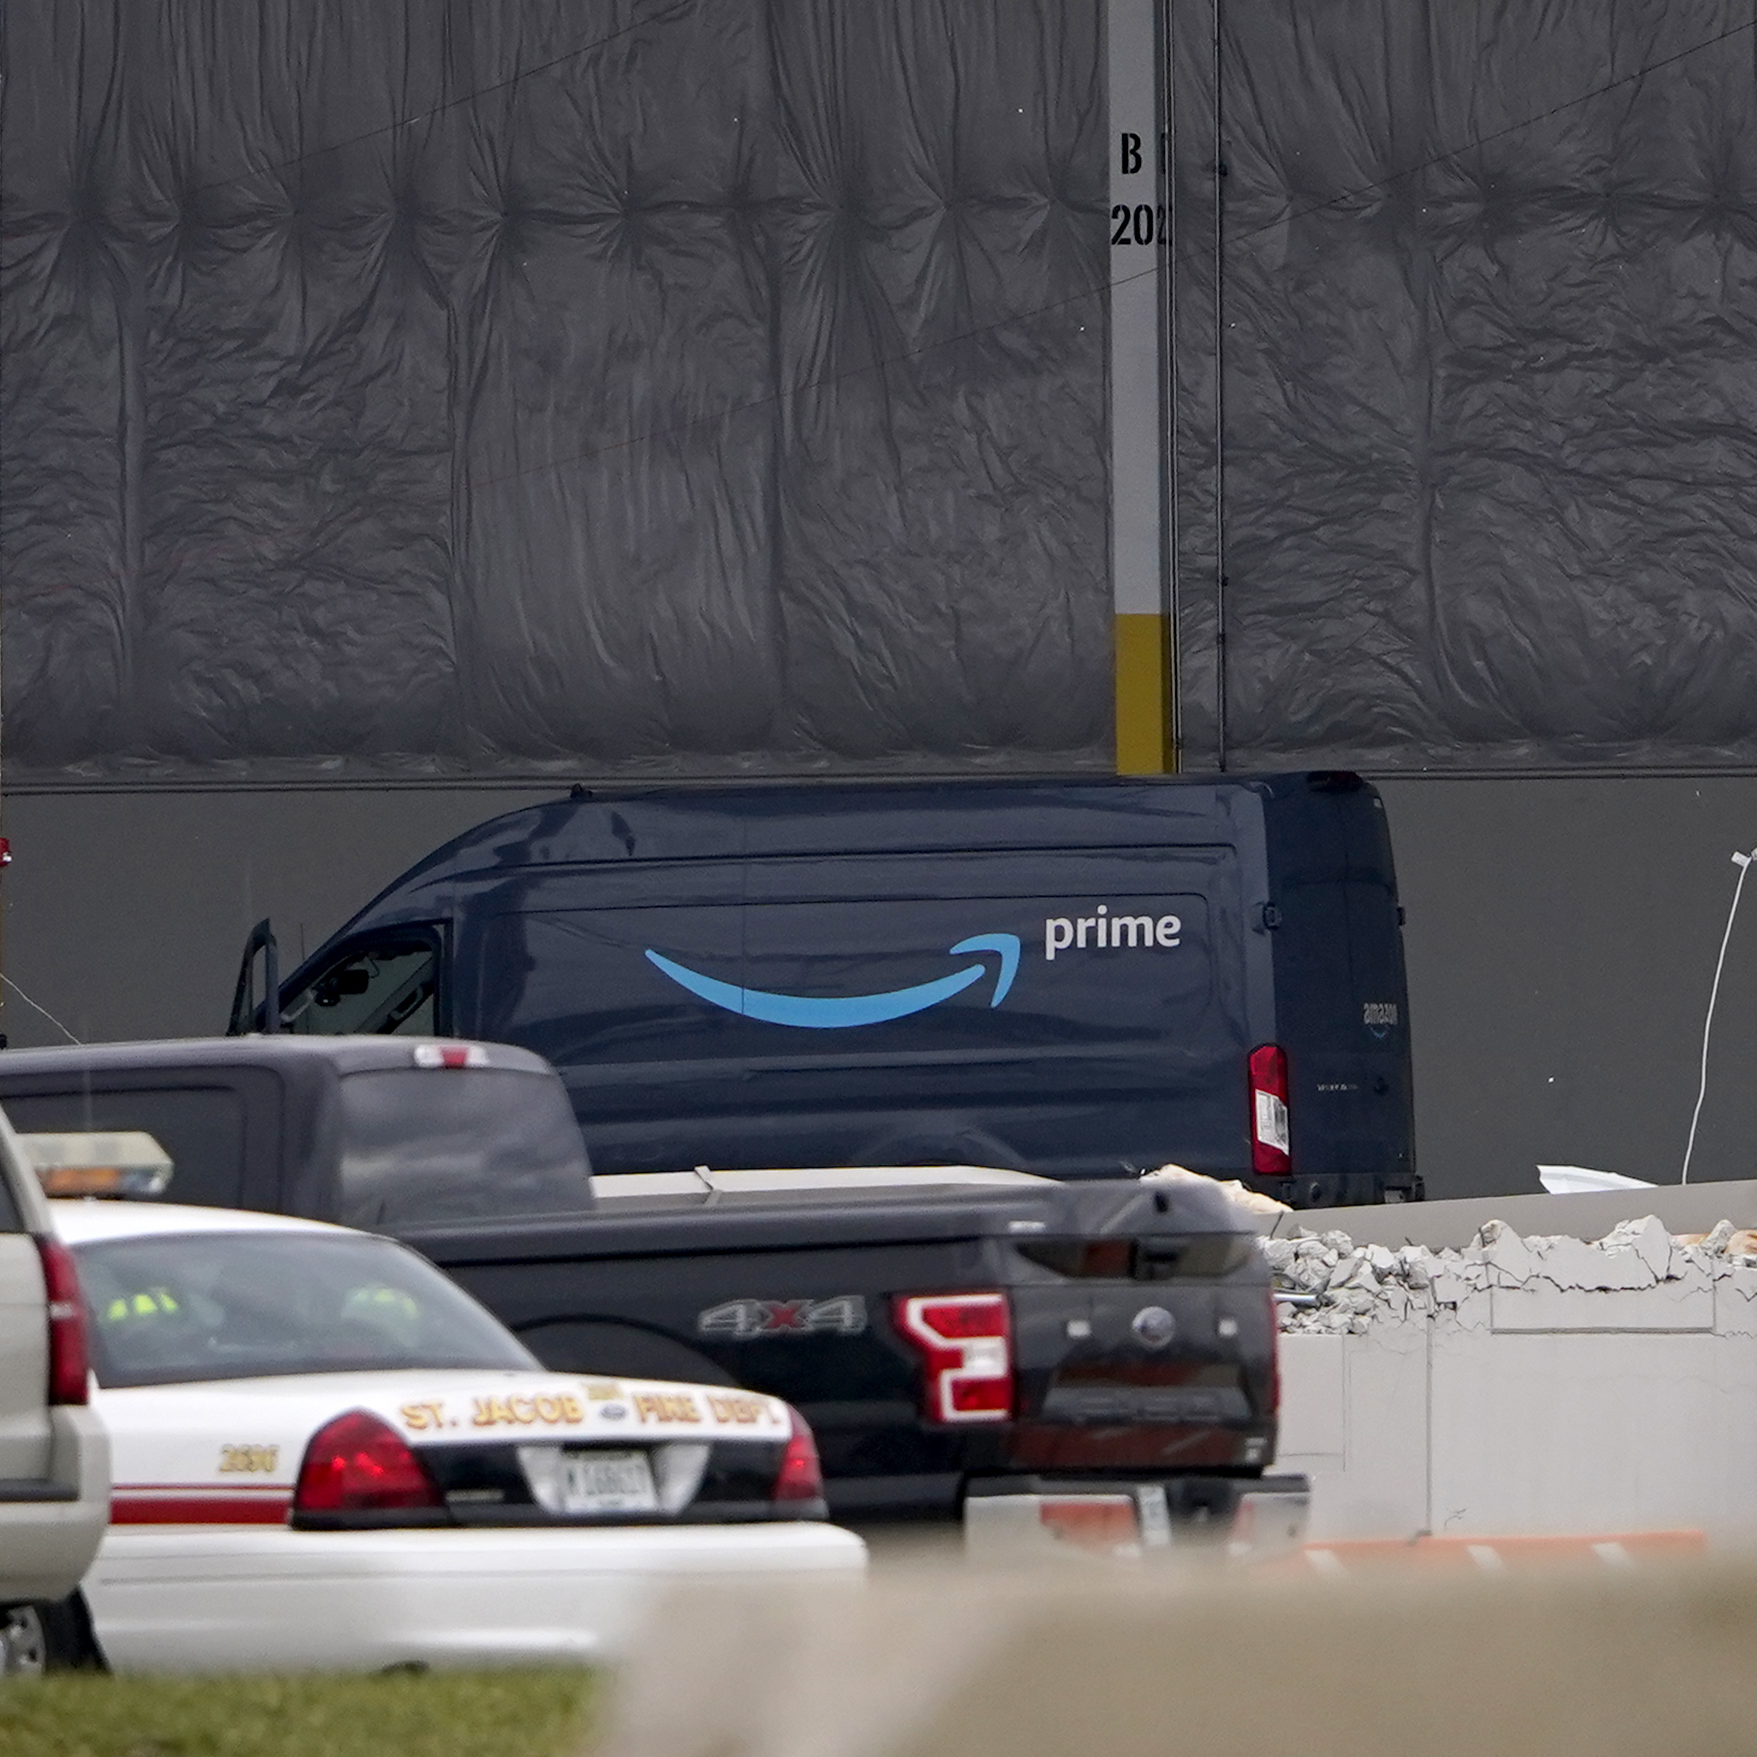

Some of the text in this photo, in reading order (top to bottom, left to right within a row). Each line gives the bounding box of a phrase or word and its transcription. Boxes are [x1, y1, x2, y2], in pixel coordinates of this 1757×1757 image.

[1121, 133, 1142, 174] B
[1111, 204, 1154, 246] 20
[1045, 905, 1182, 961] prime
[473, 1393, 584, 1428] JACOB
[633, 1394, 702, 1425] FIRE
